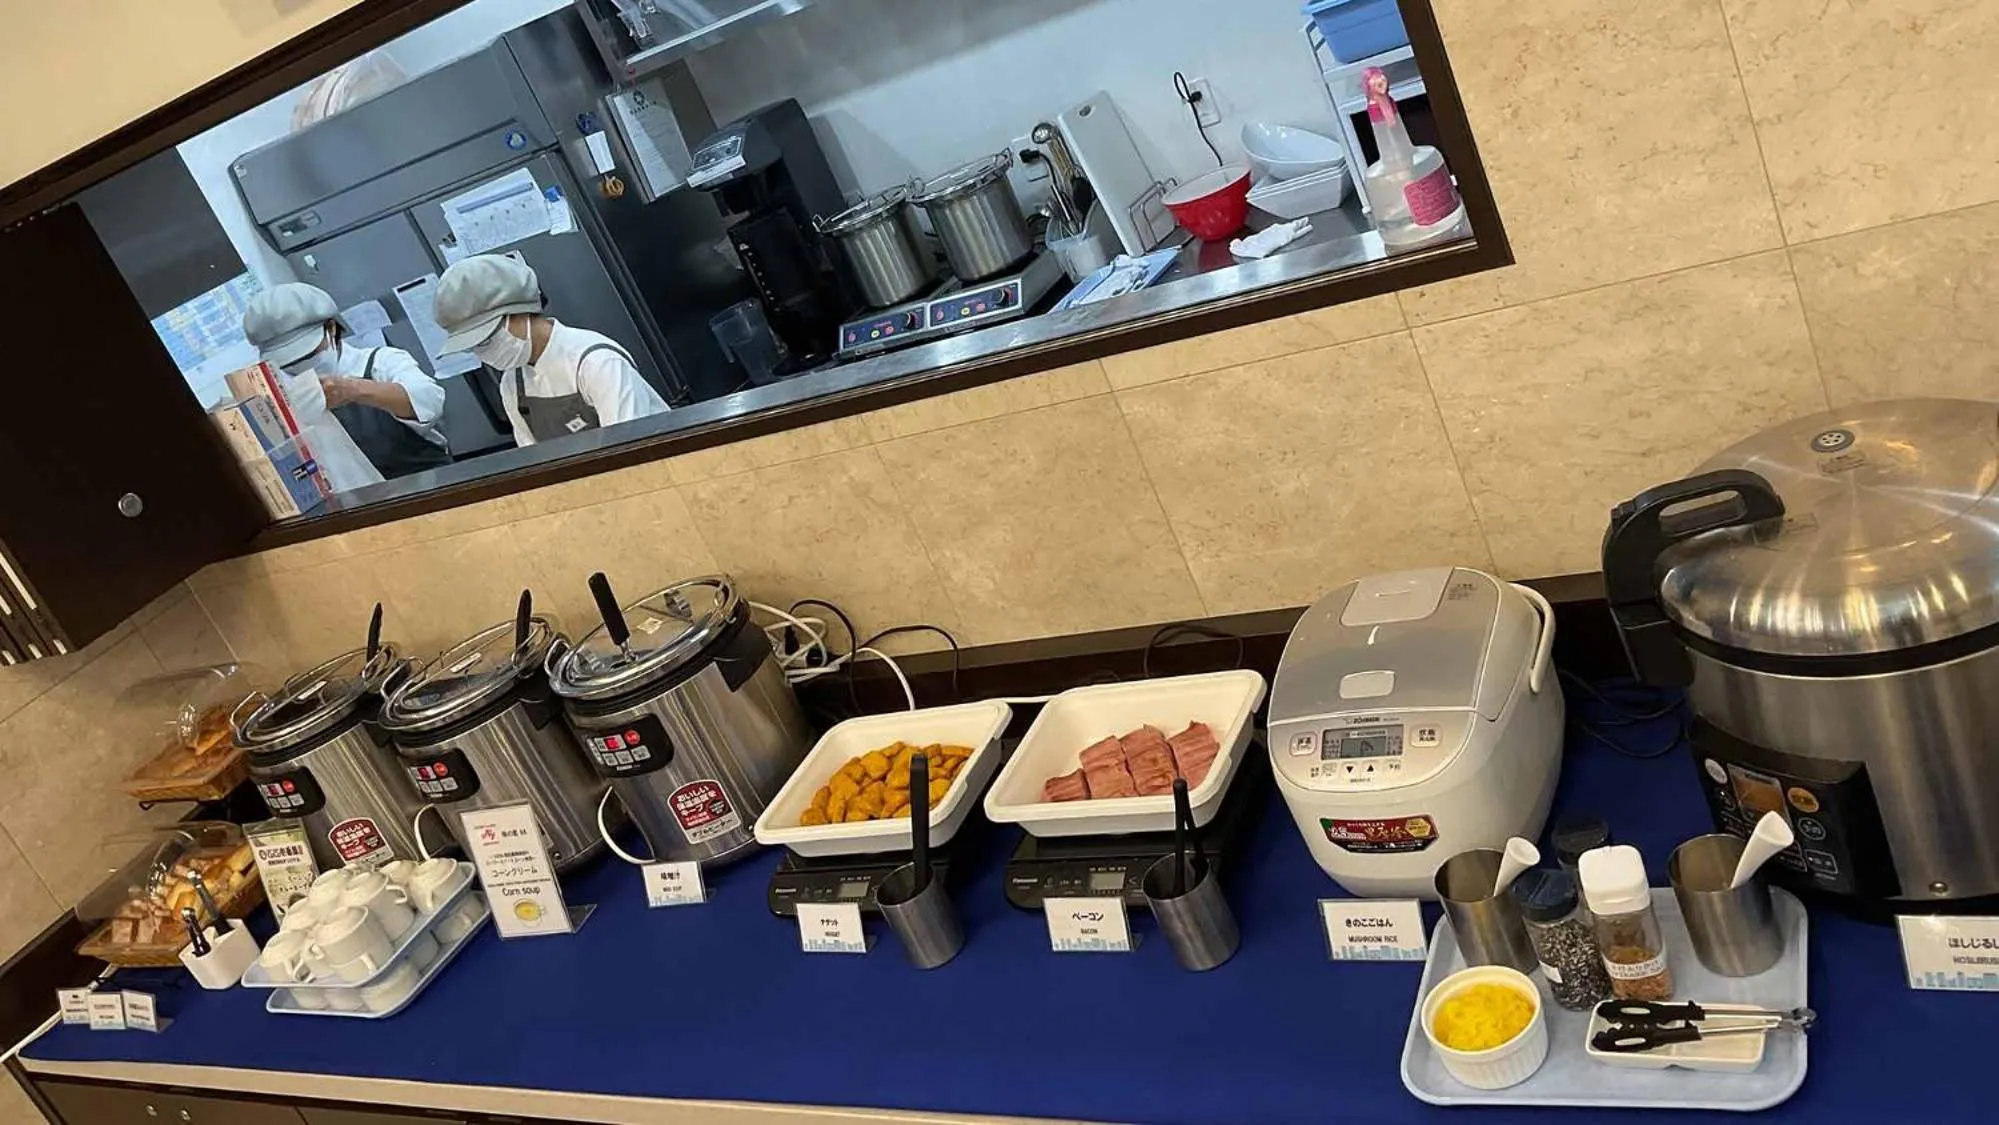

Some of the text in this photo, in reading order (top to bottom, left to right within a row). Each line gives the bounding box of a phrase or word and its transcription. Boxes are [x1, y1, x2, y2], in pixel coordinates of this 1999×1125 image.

[502, 886, 541, 897] Corn soup
[1072, 911, 1105, 922] ベーコン
[1345, 917, 1394, 928] きのこごはん
[1348, 934, 1399, 943] MUSHROOM RICE
